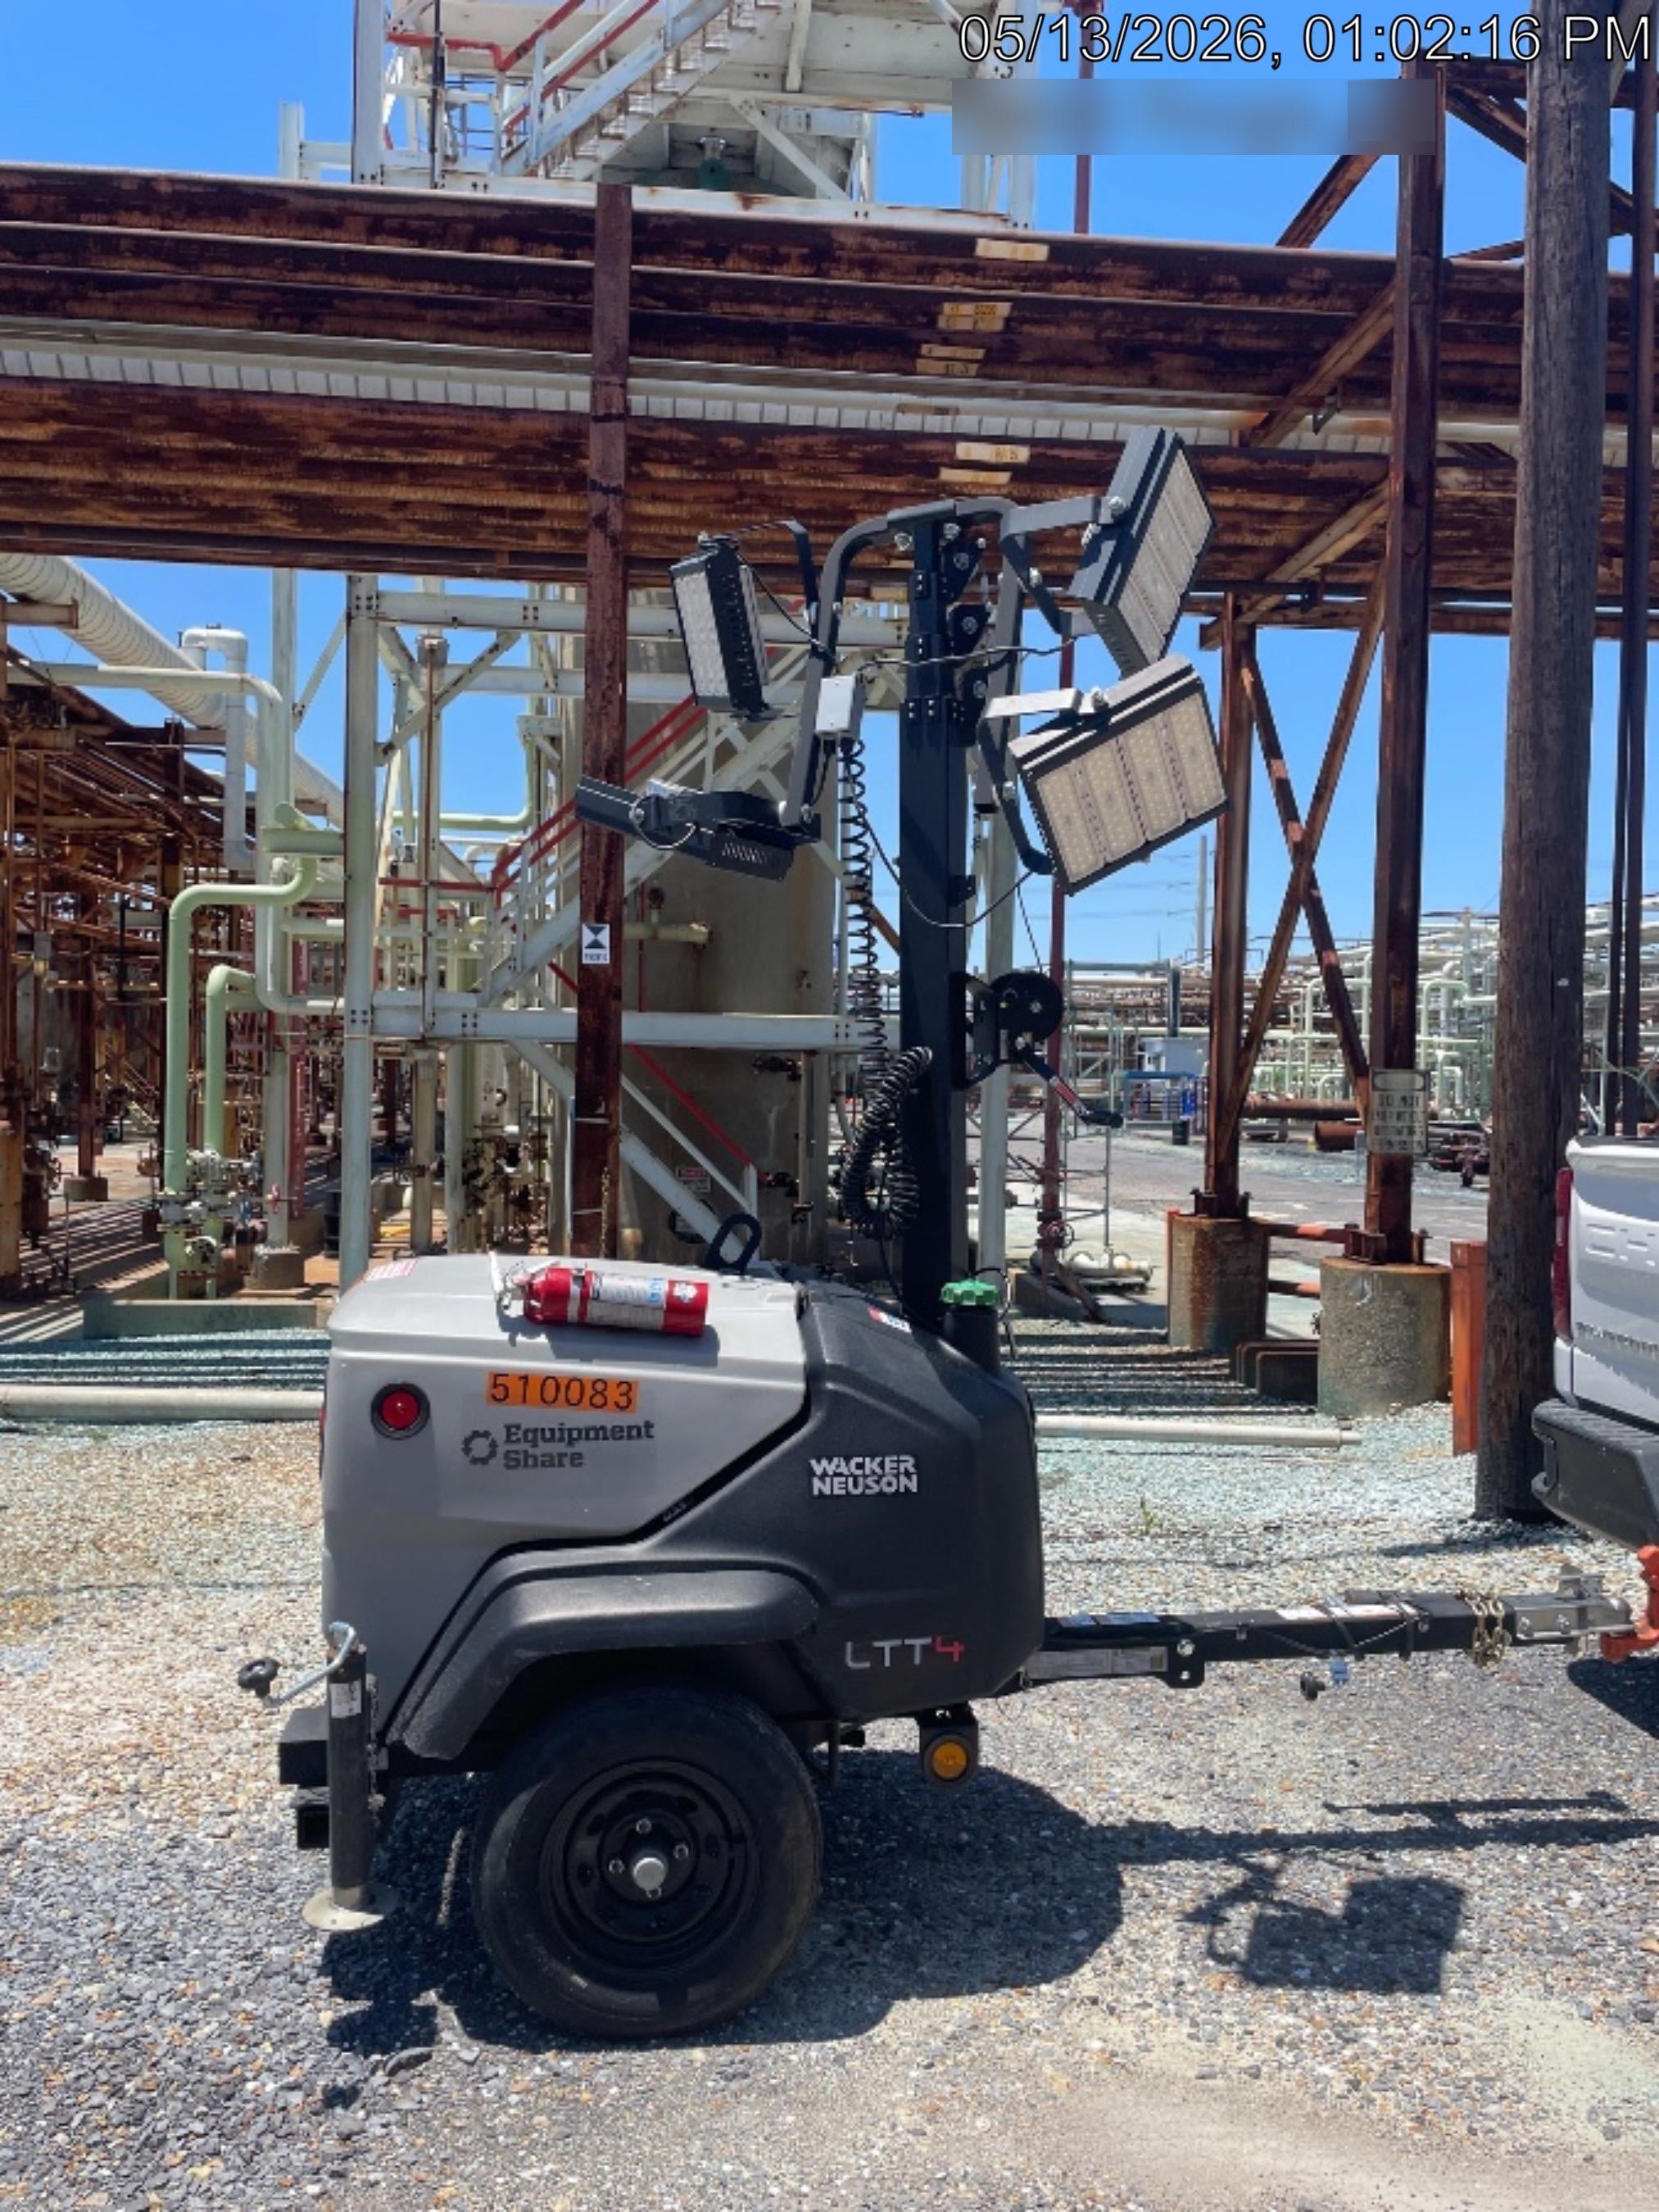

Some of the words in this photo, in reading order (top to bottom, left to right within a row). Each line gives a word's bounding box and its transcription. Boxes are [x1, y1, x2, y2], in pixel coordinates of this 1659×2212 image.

[492, 1373, 632, 1411] 510083
[503, 1420, 655, 1448] Equipment
[503, 1449, 584, 1470] Share
[809, 1455, 917, 1475] WACKER
[812, 1474, 918, 1496] NEUSON
[845, 1636, 966, 1669] LTT4
